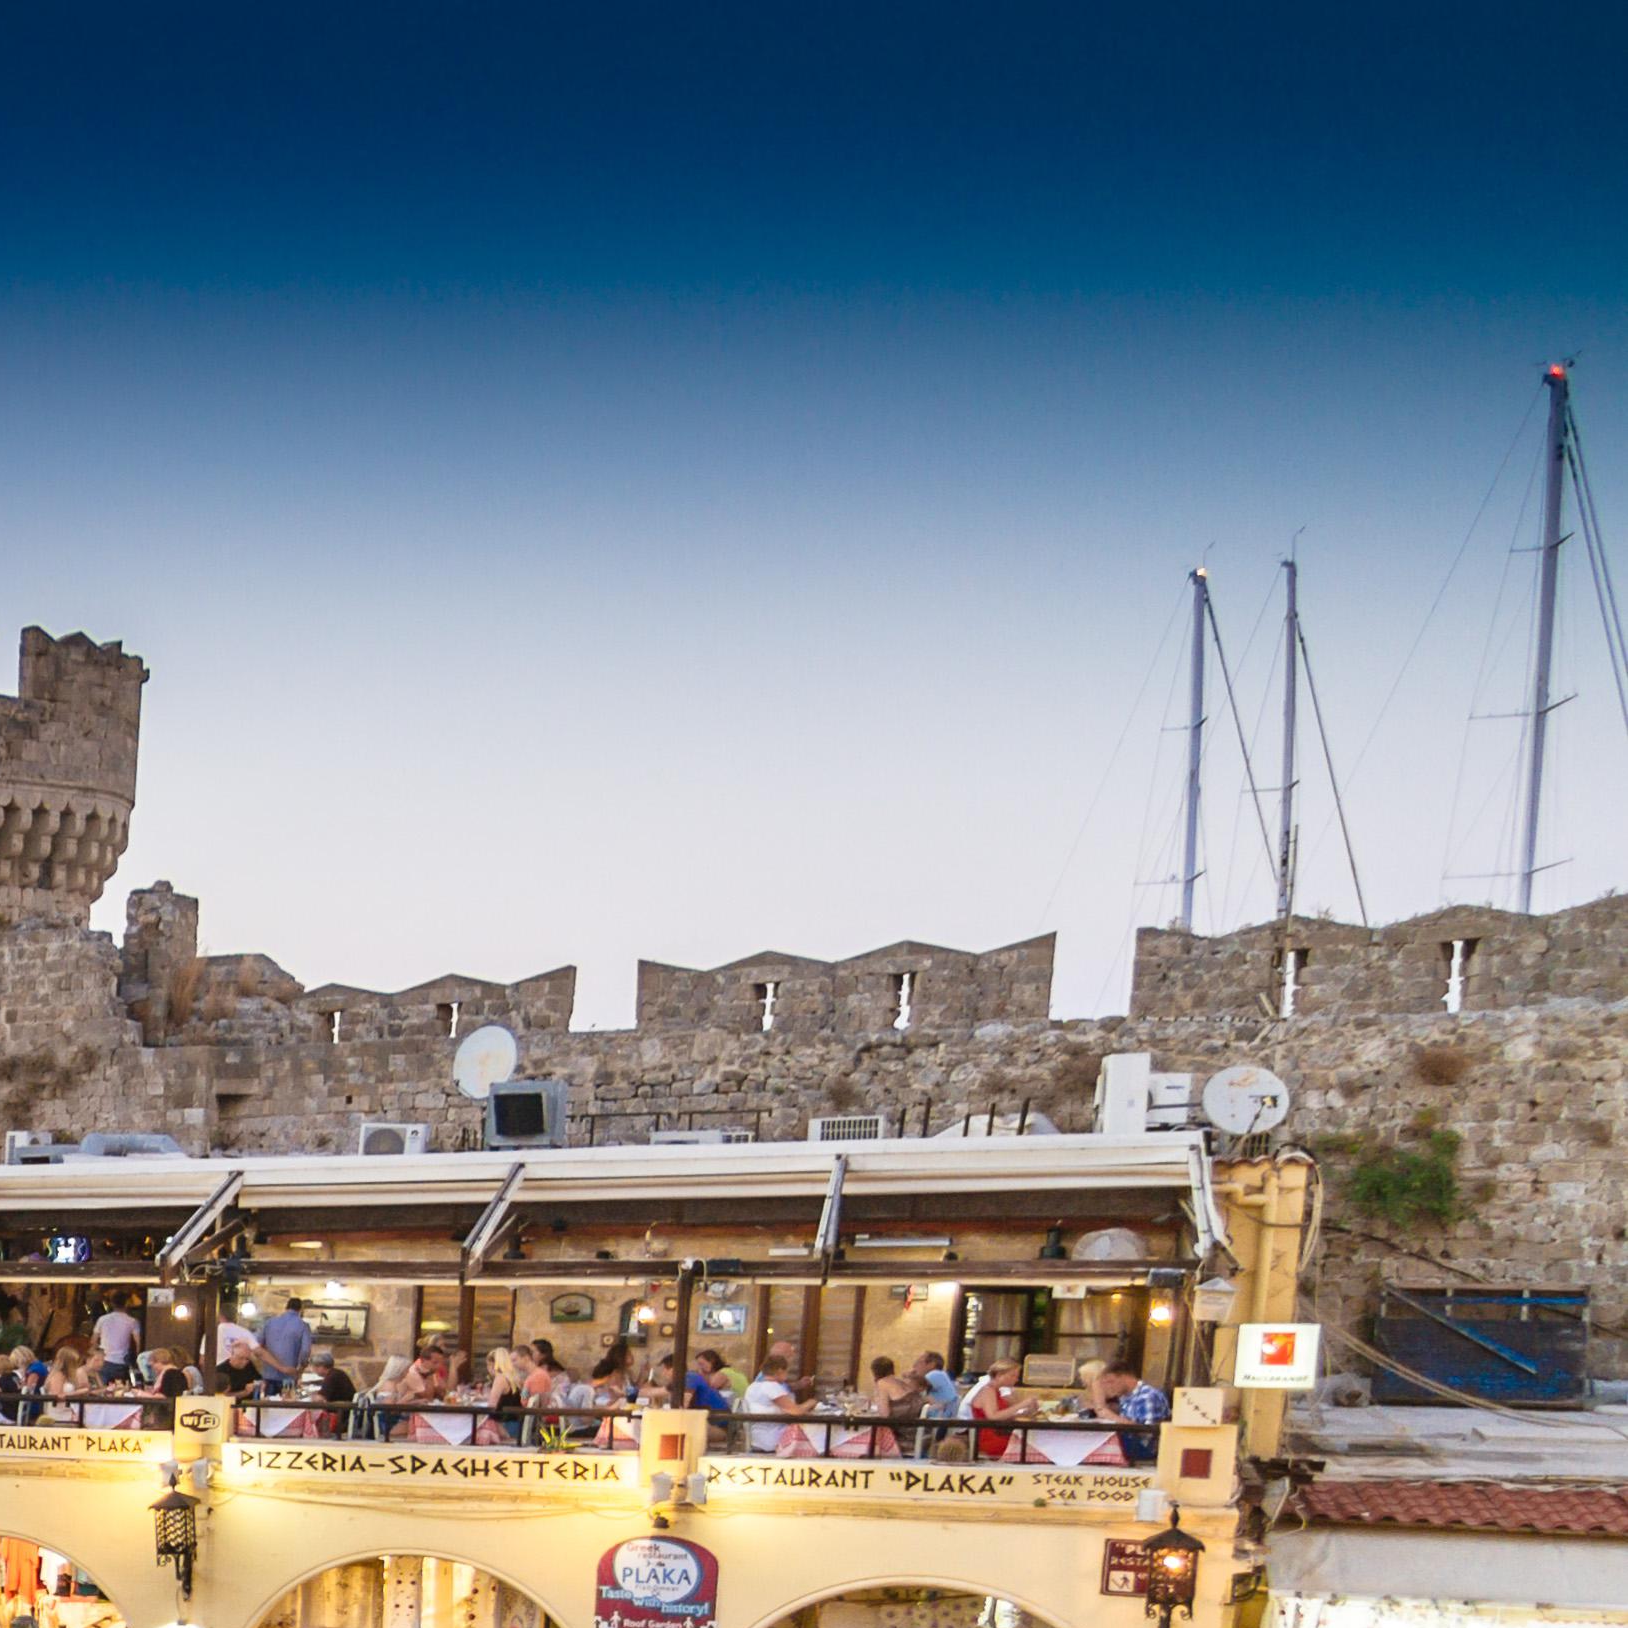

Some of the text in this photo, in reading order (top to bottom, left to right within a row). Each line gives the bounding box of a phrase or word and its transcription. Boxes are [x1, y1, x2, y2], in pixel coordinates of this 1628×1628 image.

[78, 1434, 152, 1454] "PLAKA"
[240, 1449, 620, 1481] PIZZERIA-SPAGHETTERIA
[707, 1463, 1014, 1495] RESTAURANT "PLAKA"
[1032, 1472, 1152, 1490] STEAK HOUSE
[1046, 1487, 1135, 1502] SEA FOOD
[626, 1542, 660, 1553] Greek
[637, 1552, 688, 1560] restaurant
[622, 1567, 692, 1585] PLAKA
[599, 1586, 634, 1599] Taste
[633, 1595, 662, 1609] with
[661, 1602, 709, 1617] history!
[623, 1618, 683, 1628] Roof Garden
